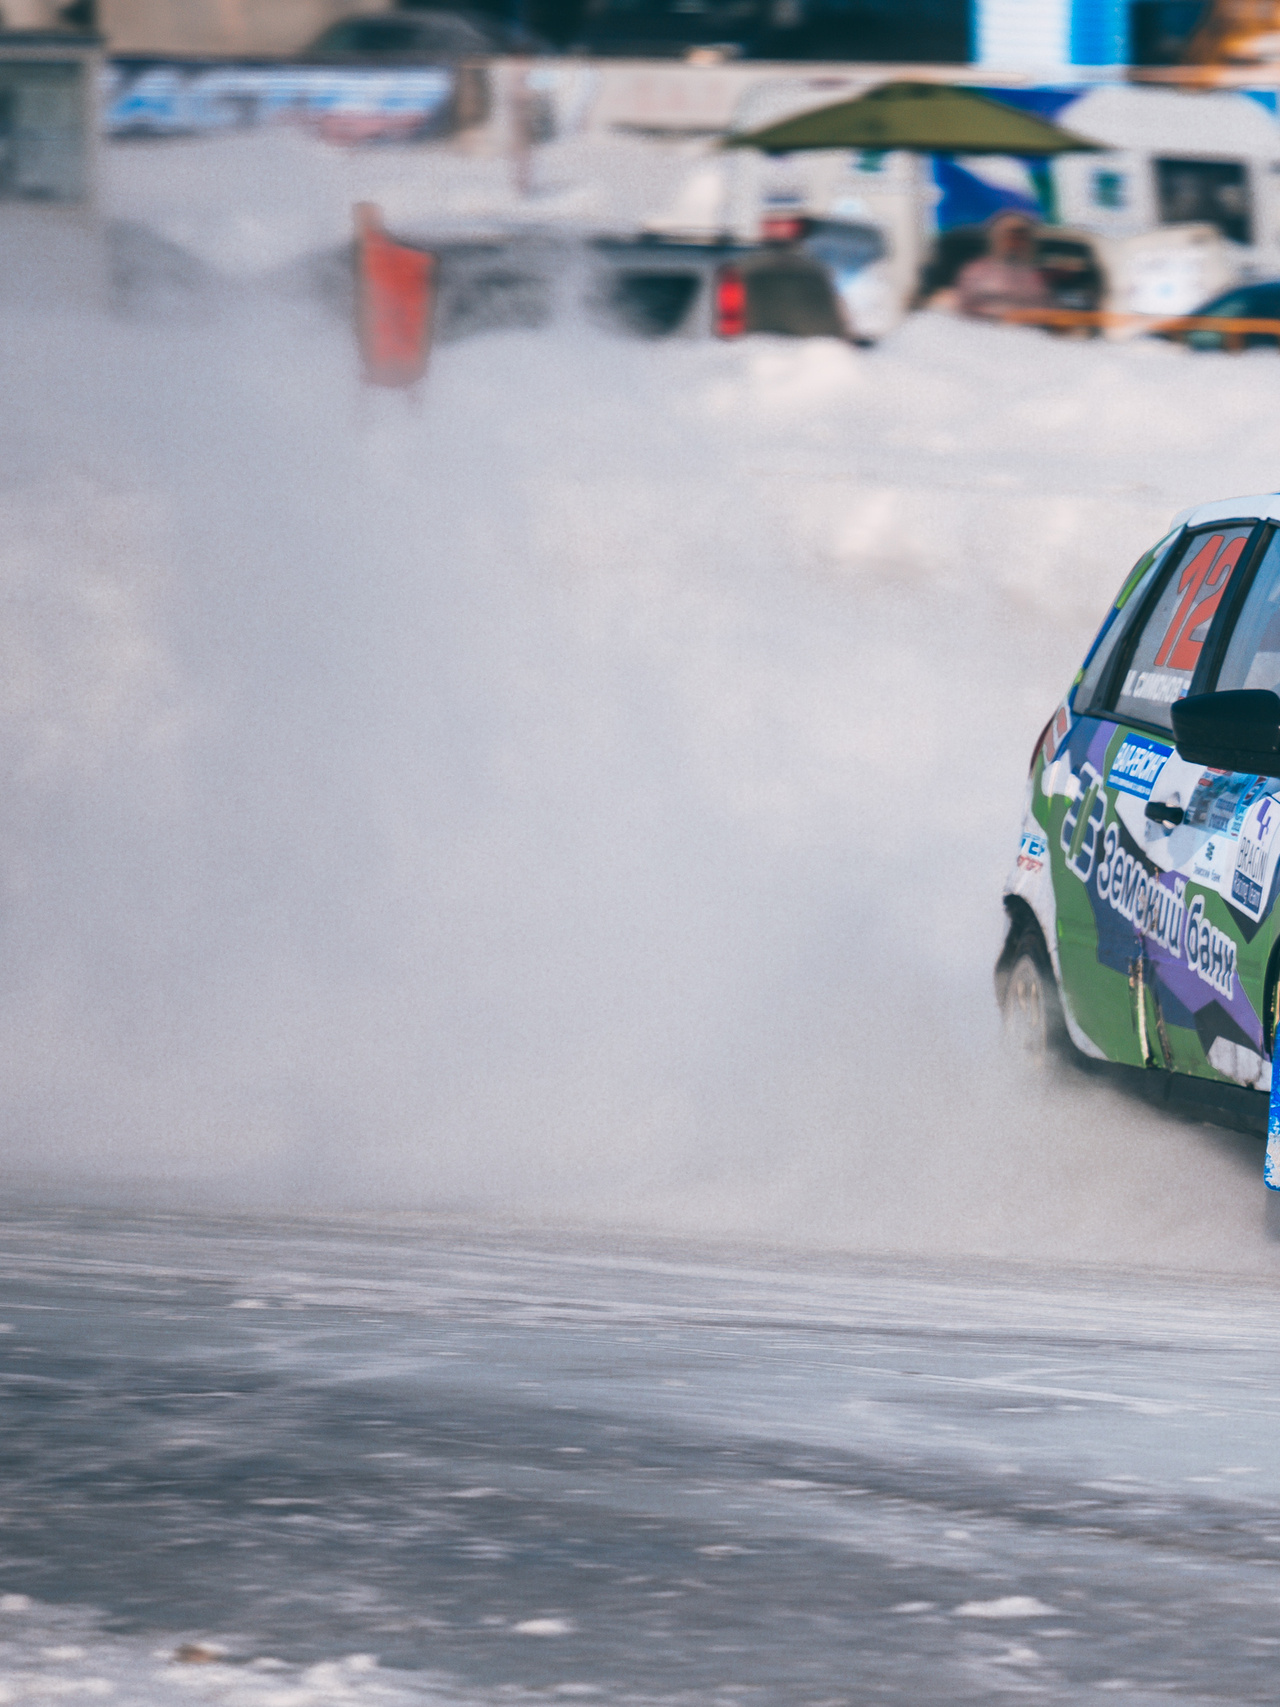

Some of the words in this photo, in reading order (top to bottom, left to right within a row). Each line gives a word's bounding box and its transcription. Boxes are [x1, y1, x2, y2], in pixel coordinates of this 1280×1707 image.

[1154, 535, 1248, 671] 12
[1097, 821, 1186, 958] Земский
[1184, 894, 1237, 1001] банк
